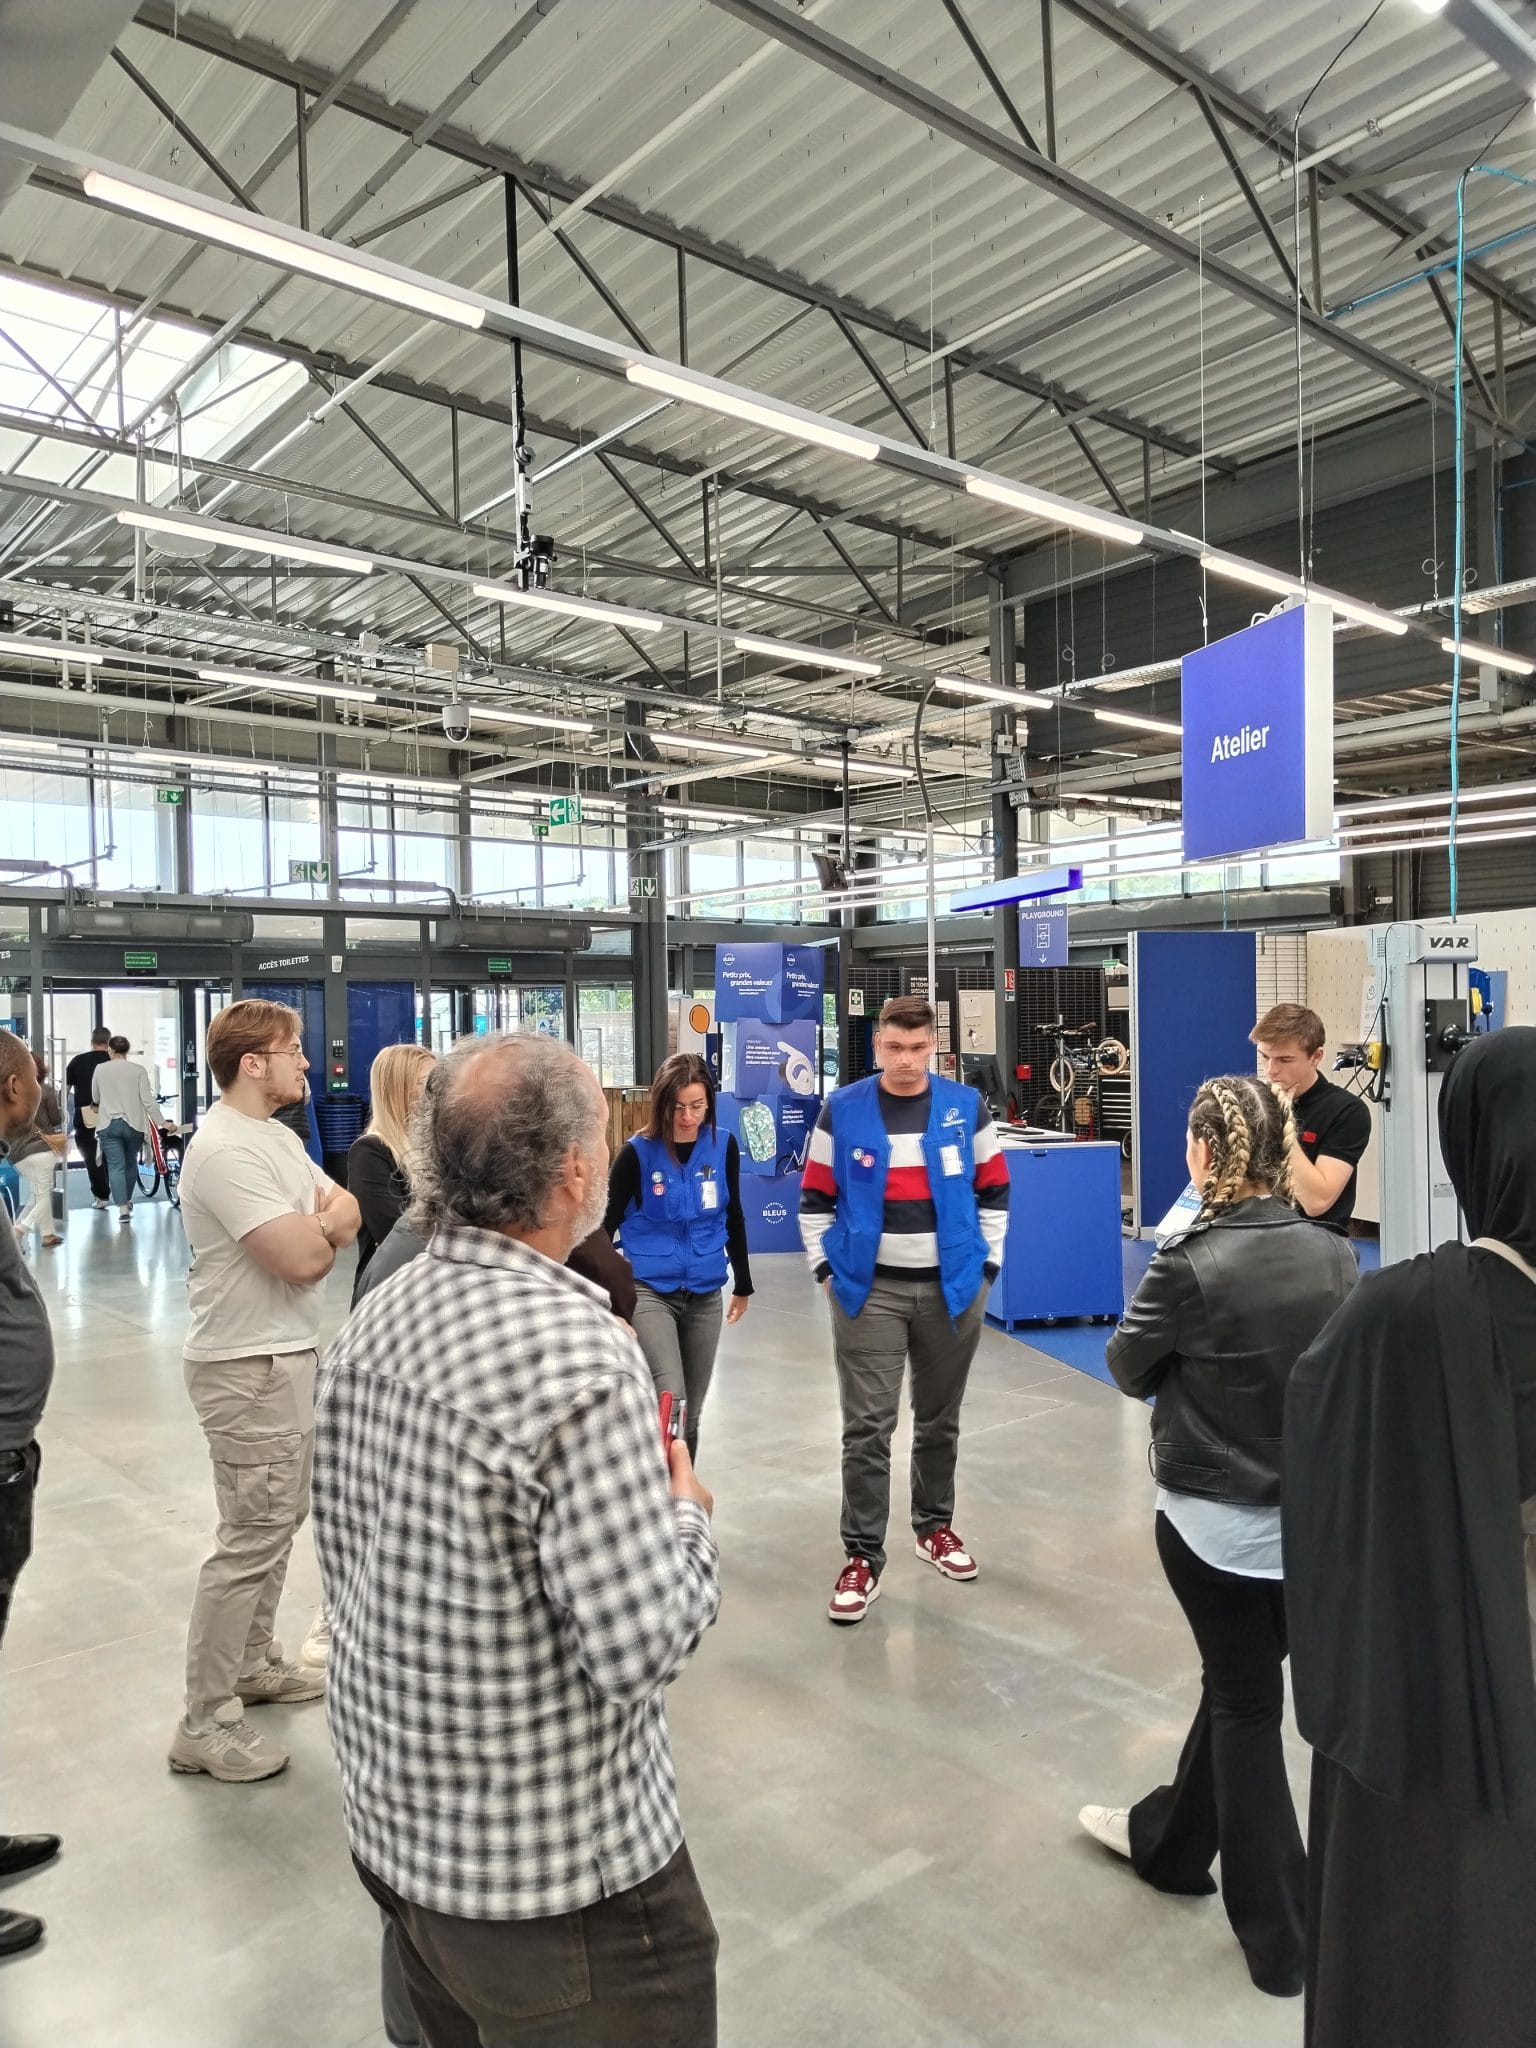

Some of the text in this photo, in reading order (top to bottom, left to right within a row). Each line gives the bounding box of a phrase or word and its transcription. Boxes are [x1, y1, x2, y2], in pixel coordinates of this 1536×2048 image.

[1211, 725, 1270, 763] Atelier
[1021, 910, 1064, 920] PLAYGROUND
[1429, 937, 1472, 948] VAR
[258, 955, 310, 970] ACCÈS TOILETTES
